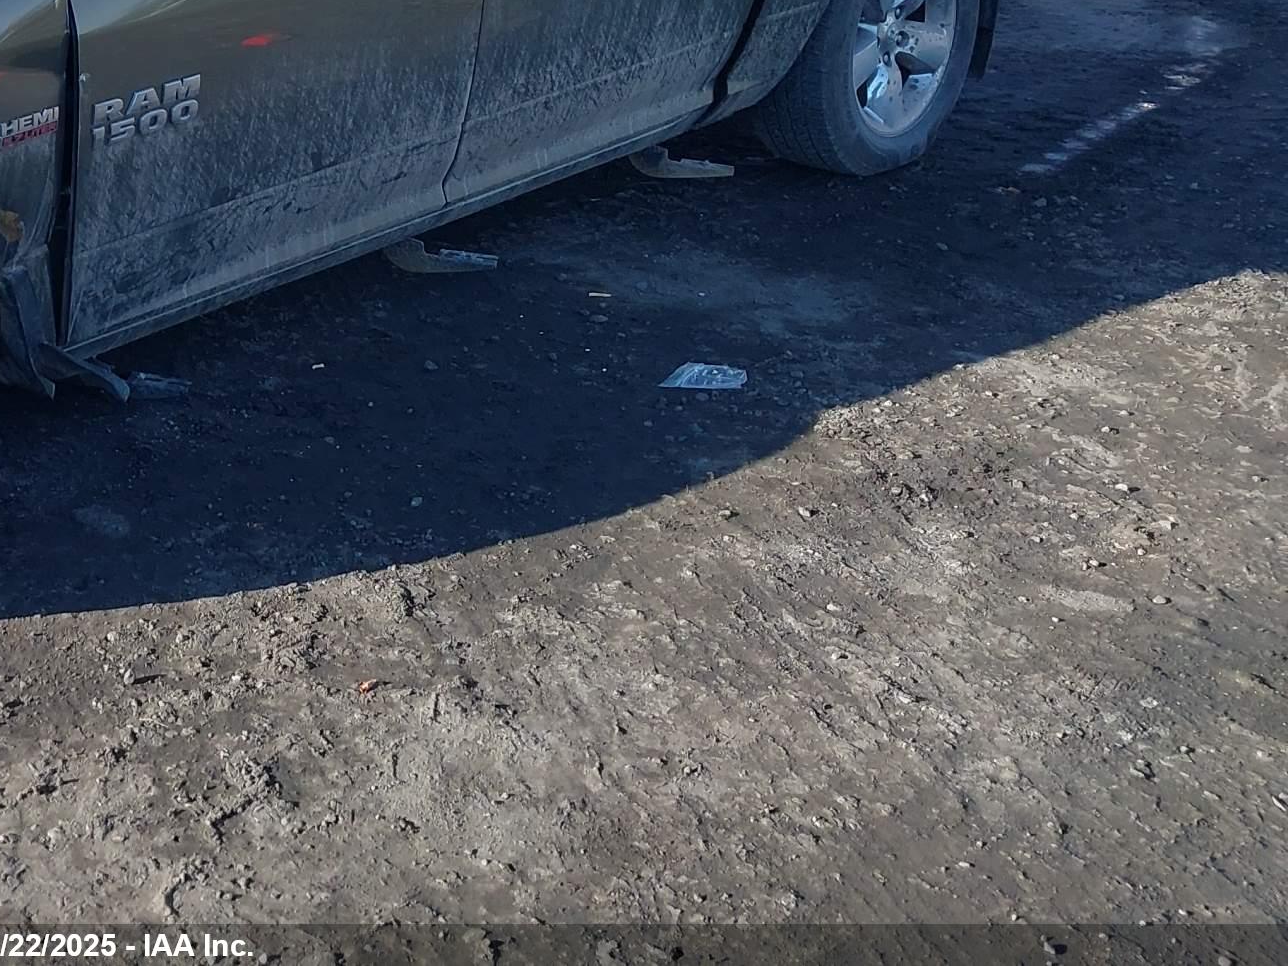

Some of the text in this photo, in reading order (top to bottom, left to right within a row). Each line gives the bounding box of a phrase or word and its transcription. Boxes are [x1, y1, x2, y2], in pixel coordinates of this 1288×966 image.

[0, 106, 60, 137] HEMI
[93, 74, 201, 123] RAM
[92, 99, 200, 147] 1500
